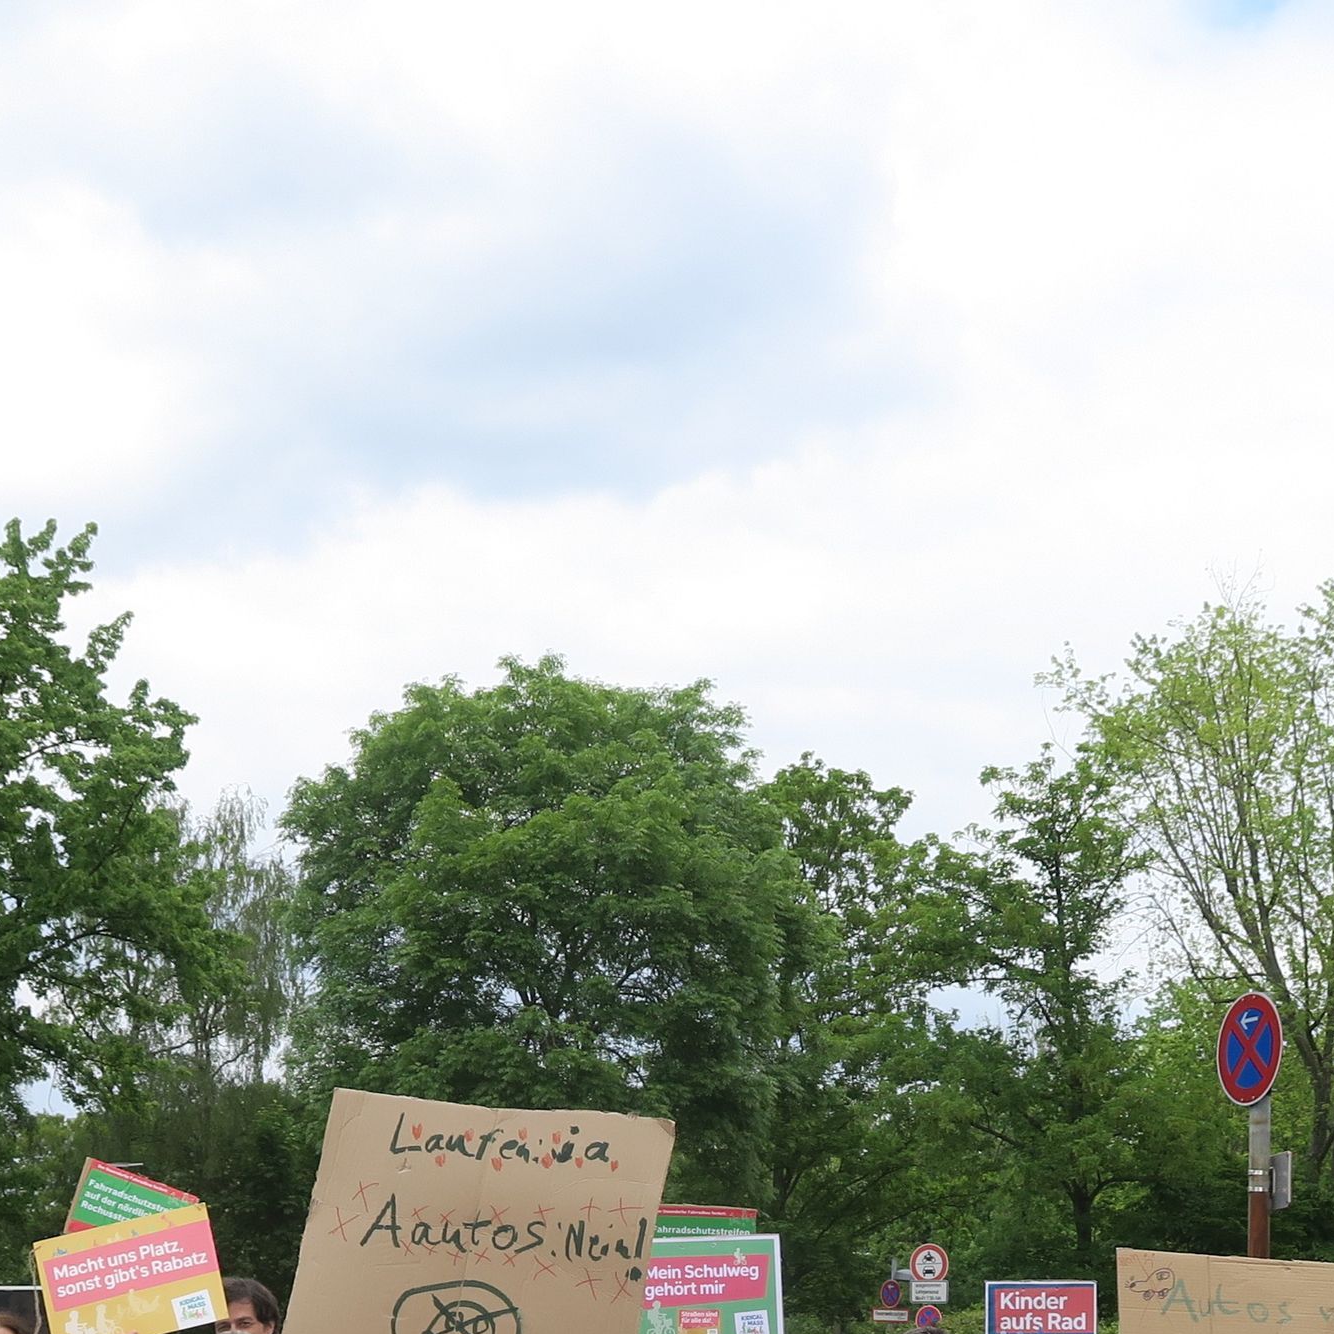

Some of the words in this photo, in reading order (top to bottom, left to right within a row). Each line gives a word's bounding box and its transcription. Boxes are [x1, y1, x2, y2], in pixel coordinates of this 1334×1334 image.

[84, 1190, 105, 1202] auf
[101, 1194, 116, 1207] der
[53, 1257, 105, 1280] Macht
[107, 1250, 138, 1268] uns
[138, 1240, 185, 1260] Platz,
[57, 1275, 105, 1298] sonst
[104, 1263, 151, 1290] gibt's
[151, 1252, 208, 1275] Rabatz
[646, 1265, 682, 1279] Mein
[684, 1263, 760, 1281] Schulweg
[645, 1281, 697, 1301] gehört
[700, 1280, 725, 1295] mir
[1000, 1291, 1068, 1310] Kinder
[1159, 1278, 1294, 1325] Autos
[999, 1312, 1043, 1331] aufs
[1048, 1312, 1087, 1330] Rad
